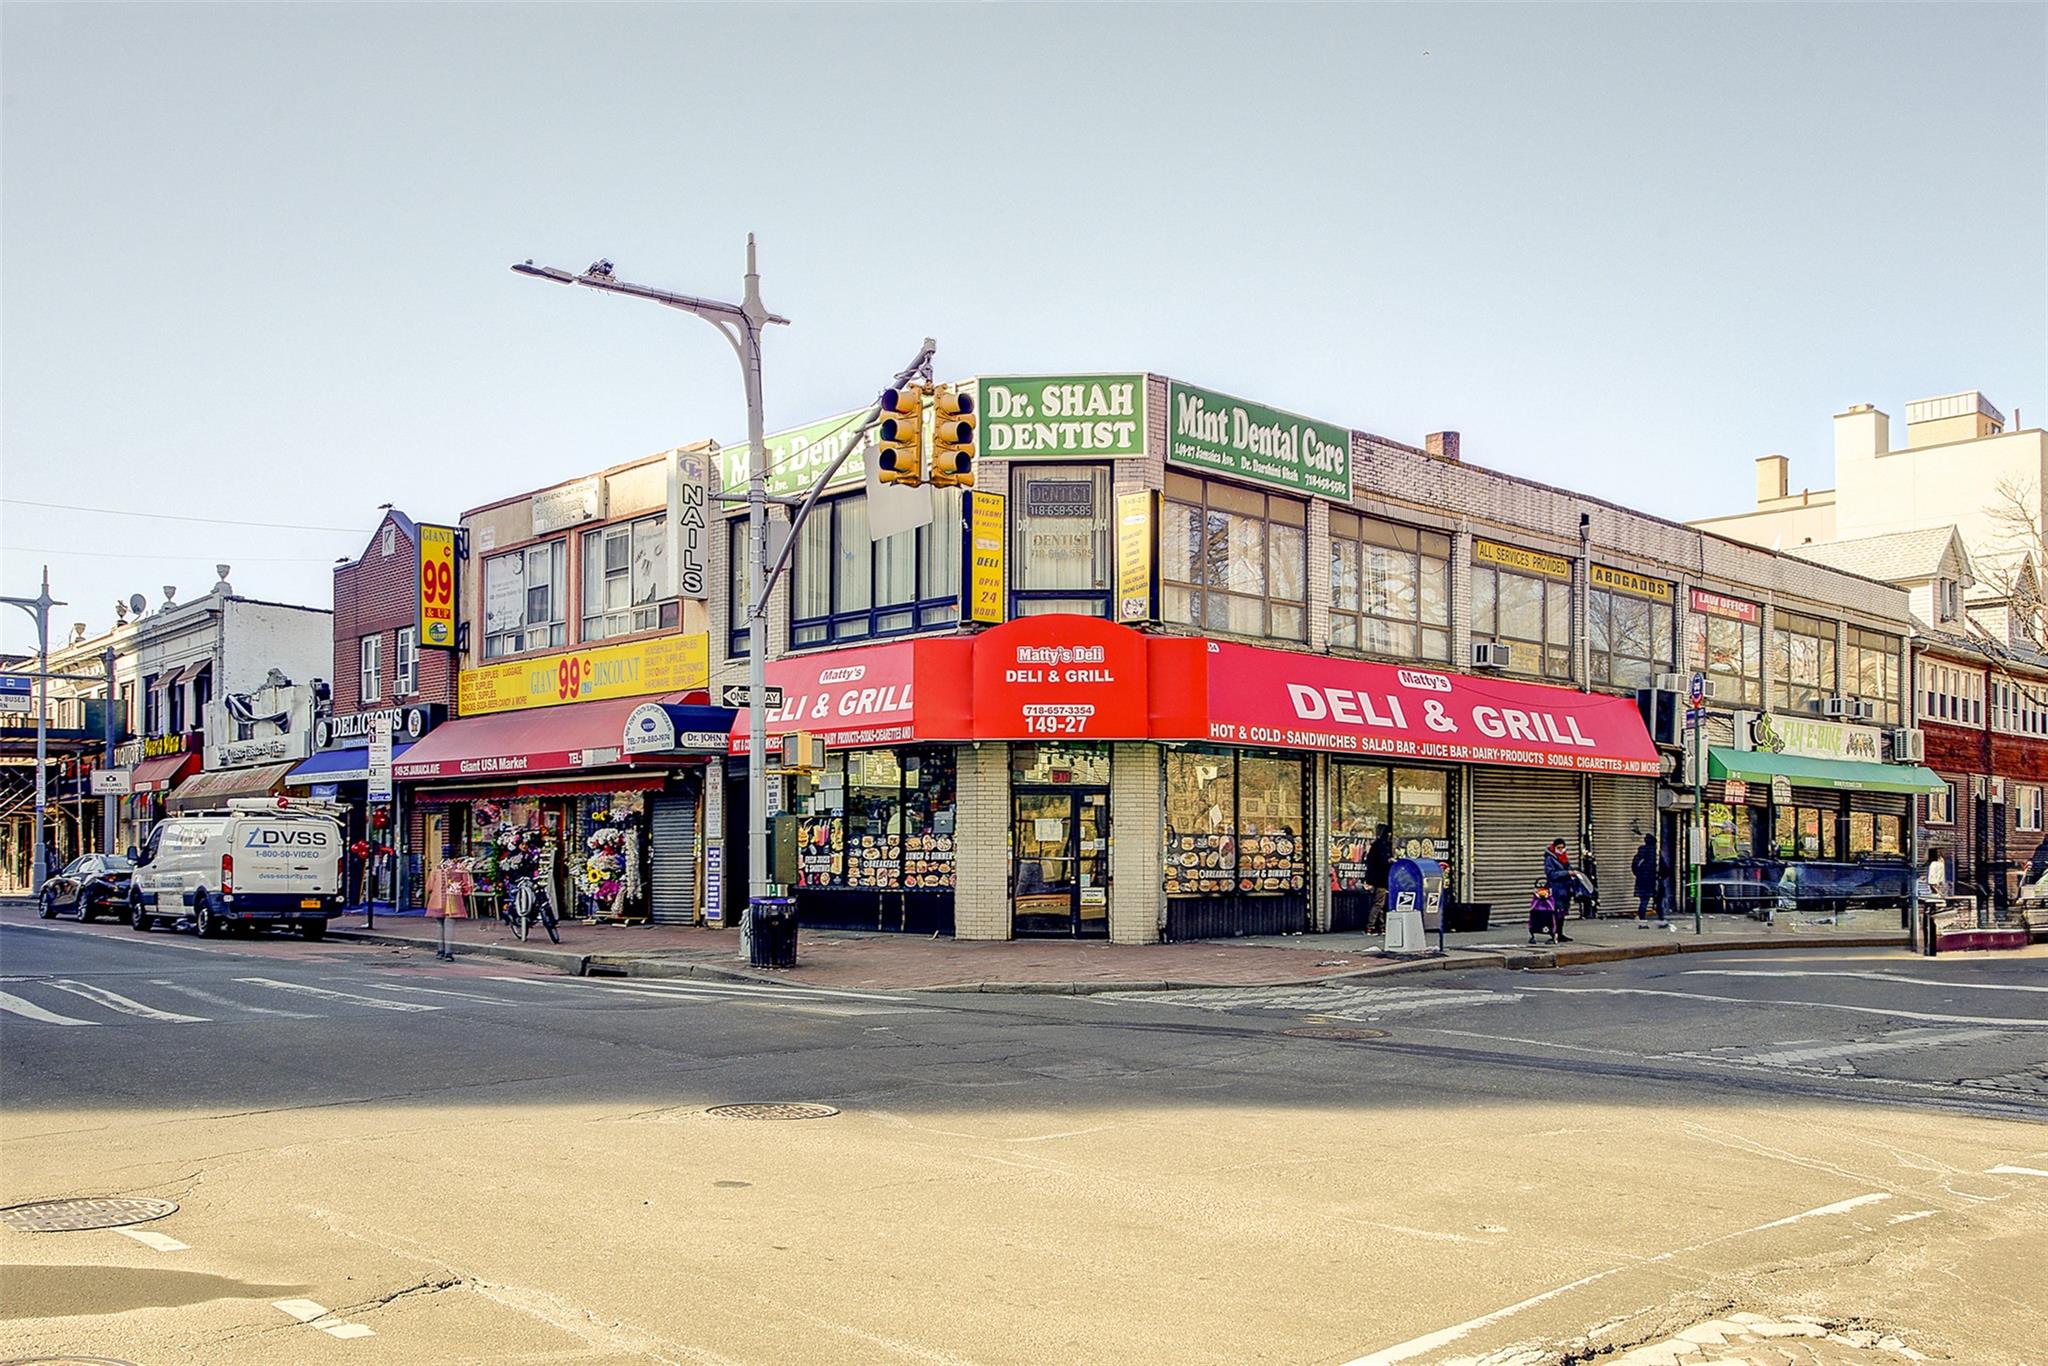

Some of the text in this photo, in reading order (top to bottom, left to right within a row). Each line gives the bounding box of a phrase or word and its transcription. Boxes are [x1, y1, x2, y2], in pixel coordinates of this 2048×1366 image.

[988, 384, 1135, 417] Dr. SHAH
[988, 421, 1136, 450] DENTIST
[1177, 391, 1345, 476] Mint Dental Care
[1195, 447, 1221, 463] Jamaica
[1221, 452, 1235, 467] Ave.
[1240, 456, 1252, 470] Dr.
[1281, 465, 1299, 482] Shah
[1032, 486, 1090, 502] DENTIST
[1030, 505, 1091, 516] 718-658-5585
[422, 528, 452, 543] GIANT
[680, 483, 705, 594] NAILS
[1033, 534, 1090, 546] DENTIST
[976, 556, 999, 568] DELI
[1479, 543, 1567, 575] ALL SERVICES PROVIDED
[423, 559, 452, 605] 99
[978, 577, 1000, 587] OPEN
[1595, 569, 1666, 596] ABOGADOS
[980, 591, 997, 604] 24
[1699, 591, 1719, 606] LAW
[1720, 597, 1750, 614] OFFICE
[426, 607, 450, 618] & UP
[974, 607, 996, 617] HOUR
[1017, 646, 1105, 666] Matty's Deli
[480, 669, 499, 681] SUPPLIES
[530, 657, 640, 700] GIANT 99 DISCOUNT
[822, 667, 862, 681] Matty's
[1005, 669, 1114, 683] DELI & GRILL
[1401, 671, 1448, 690] Matty's
[475, 680, 494, 690] SUPPLIES
[478, 689, 497, 701] SUPPLIES
[730, 692, 749, 702] ONE
[766, 683, 914, 723] ELI & GRILL
[1026, 706, 1093, 715] 718-657-3354
[1286, 682, 1597, 748] DELI & GRILL
[331, 708, 403, 739] DELICS
[1025, 716, 1088, 733] 149-27
[687, 733, 722, 743] Dr. JOHN
[1210, 723, 1236, 739] HOT
[1238, 726, 1248, 740] &
[1361, 737, 1395, 752] SALAD
[1547, 753, 1574, 767] SODAS
[1640, 760, 1661, 774] MORE
[460, 756, 528, 773] Giant USA Market
[262, 830, 327, 846] DVSS
[255, 850, 320, 858] 1-800-50-VIDEO
[931, 851, 954, 860] DINNER
